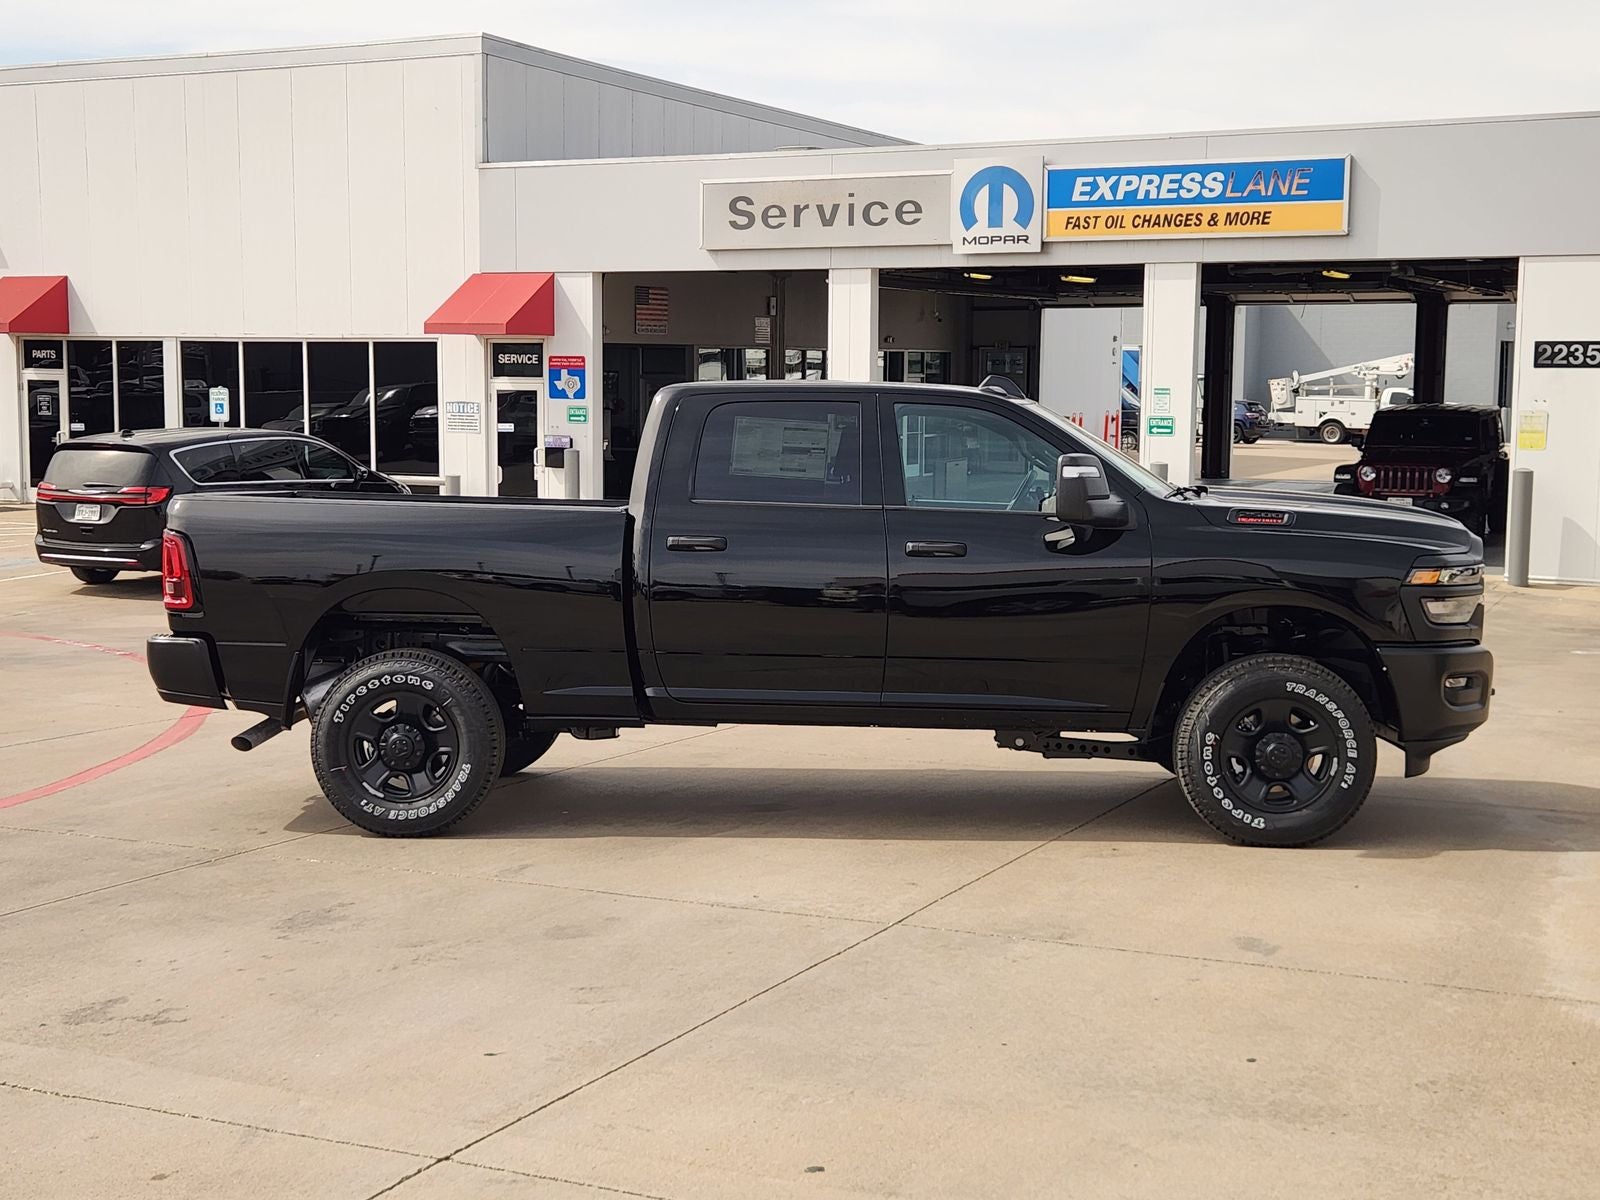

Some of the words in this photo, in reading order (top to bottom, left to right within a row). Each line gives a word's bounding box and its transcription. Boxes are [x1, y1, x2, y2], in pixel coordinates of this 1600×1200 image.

[728, 192, 923, 230] Service
[1065, 214, 1101, 230] FAST
[1104, 214, 1127, 229] OIL
[1131, 212, 1204, 228] CHANGES
[1207, 212, 1219, 226] &
[1224, 210, 1272, 226] MORE
[962, 234, 1030, 246] MOPAR
[32, 350, 56, 359] PARTS
[498, 353, 539, 364] SERVICE
[1537, 343, 1600, 366] 2235
[446, 402, 480, 414] NOTICE
[1285, 681, 1358, 759] TRANSFORCE
[388, 762, 473, 820] TRANSFORCE
